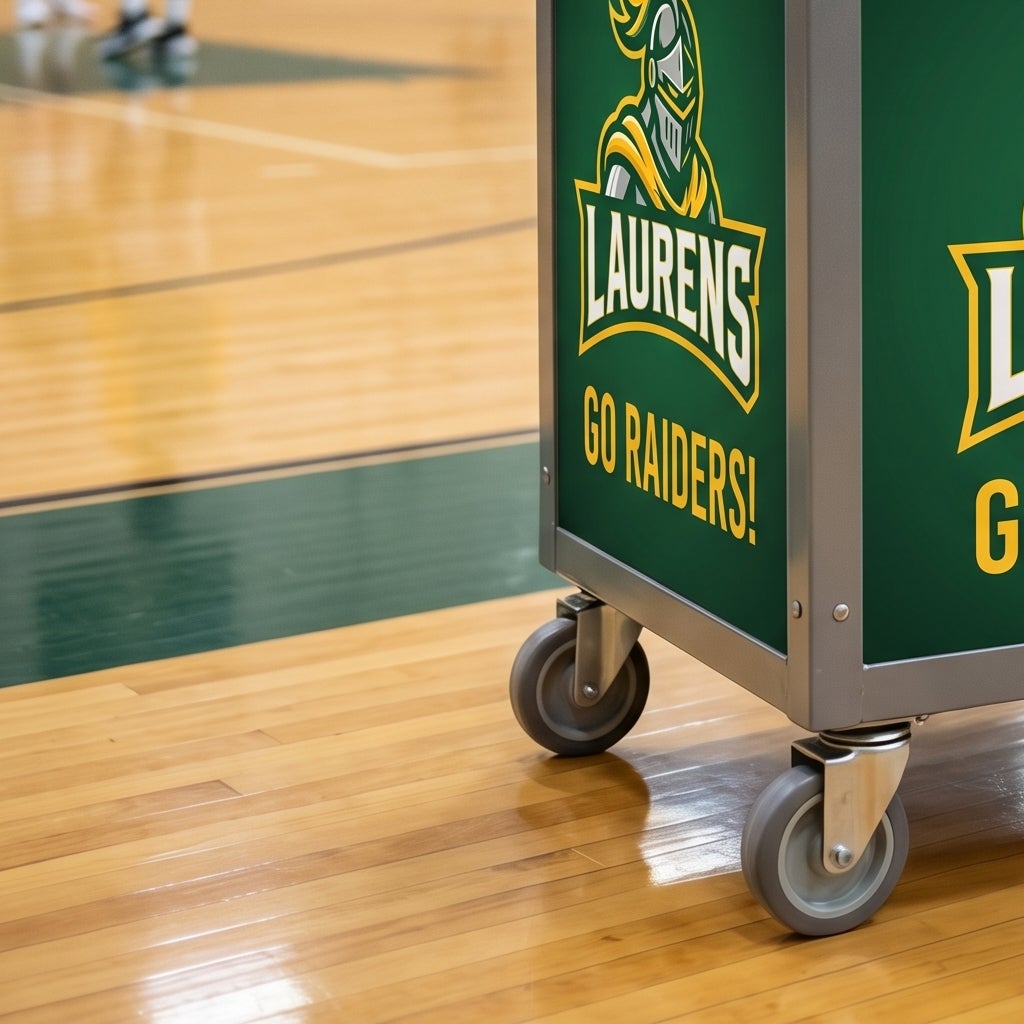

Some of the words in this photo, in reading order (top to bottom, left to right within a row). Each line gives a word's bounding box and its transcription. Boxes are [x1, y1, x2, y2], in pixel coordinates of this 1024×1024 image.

[586, 204, 751, 387] LAURENS
[583, 385, 616, 474] GO
[625, 401, 756, 545] RAIDERS!
